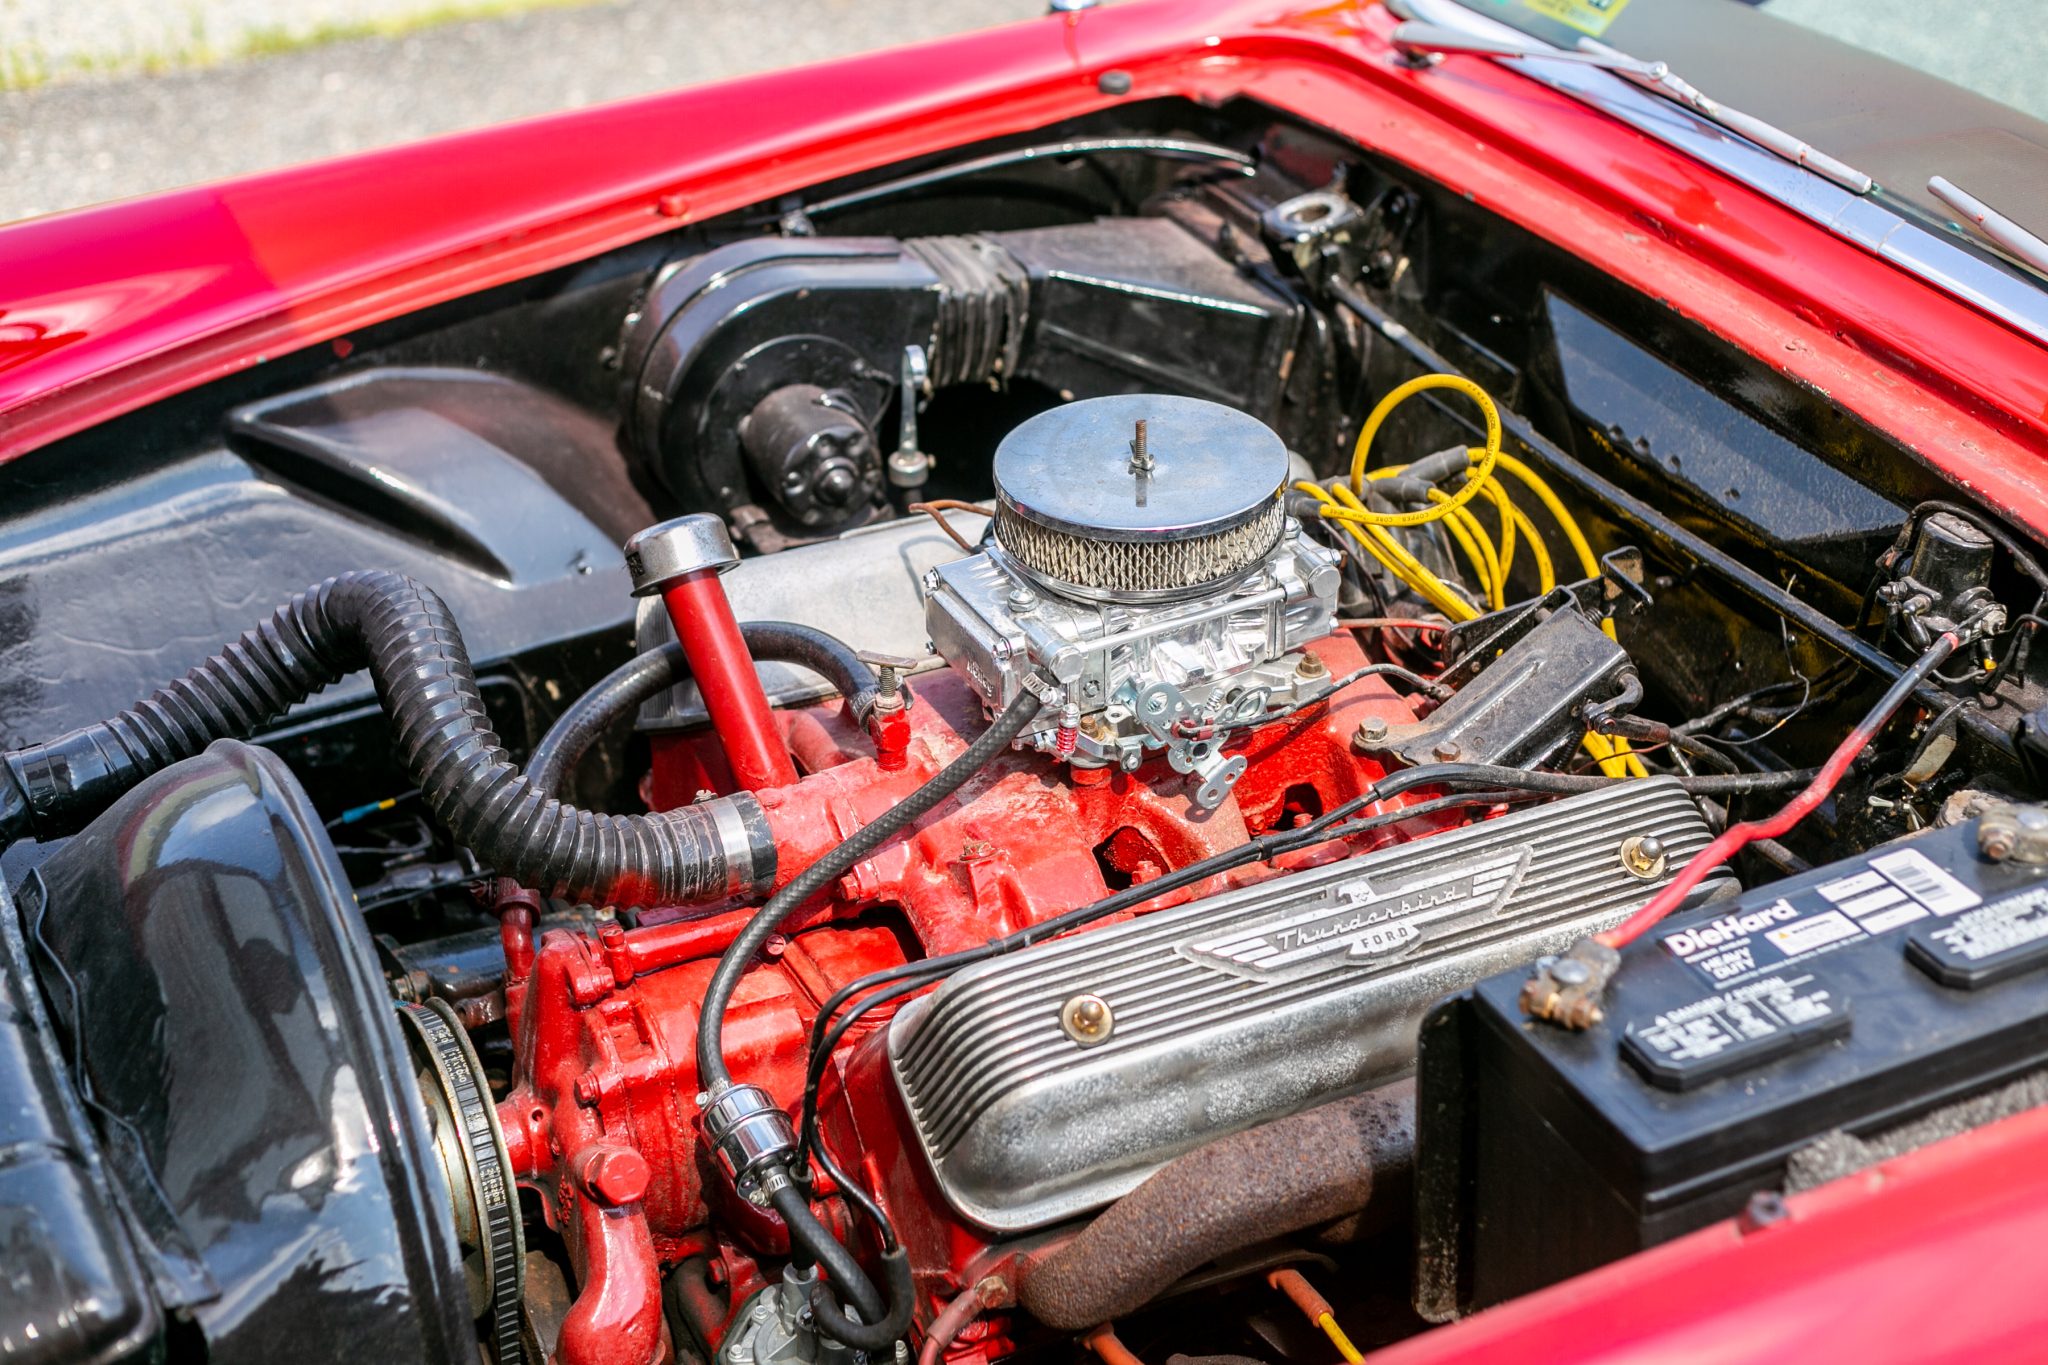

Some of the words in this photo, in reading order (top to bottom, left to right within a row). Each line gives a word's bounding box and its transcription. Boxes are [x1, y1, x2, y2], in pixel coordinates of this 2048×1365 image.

[1464, 472, 1482, 494] SUPER
[1437, 497, 1460, 514] STOCK
[1402, 512, 1429, 523] COPPER
[1276, 886, 1467, 950] Thunderbird
[1664, 898, 1799, 957] DieHard
[1360, 926, 1409, 949] FORD
[1701, 946, 1751, 973] HEAVY
[1712, 960, 1756, 980] DUTY
